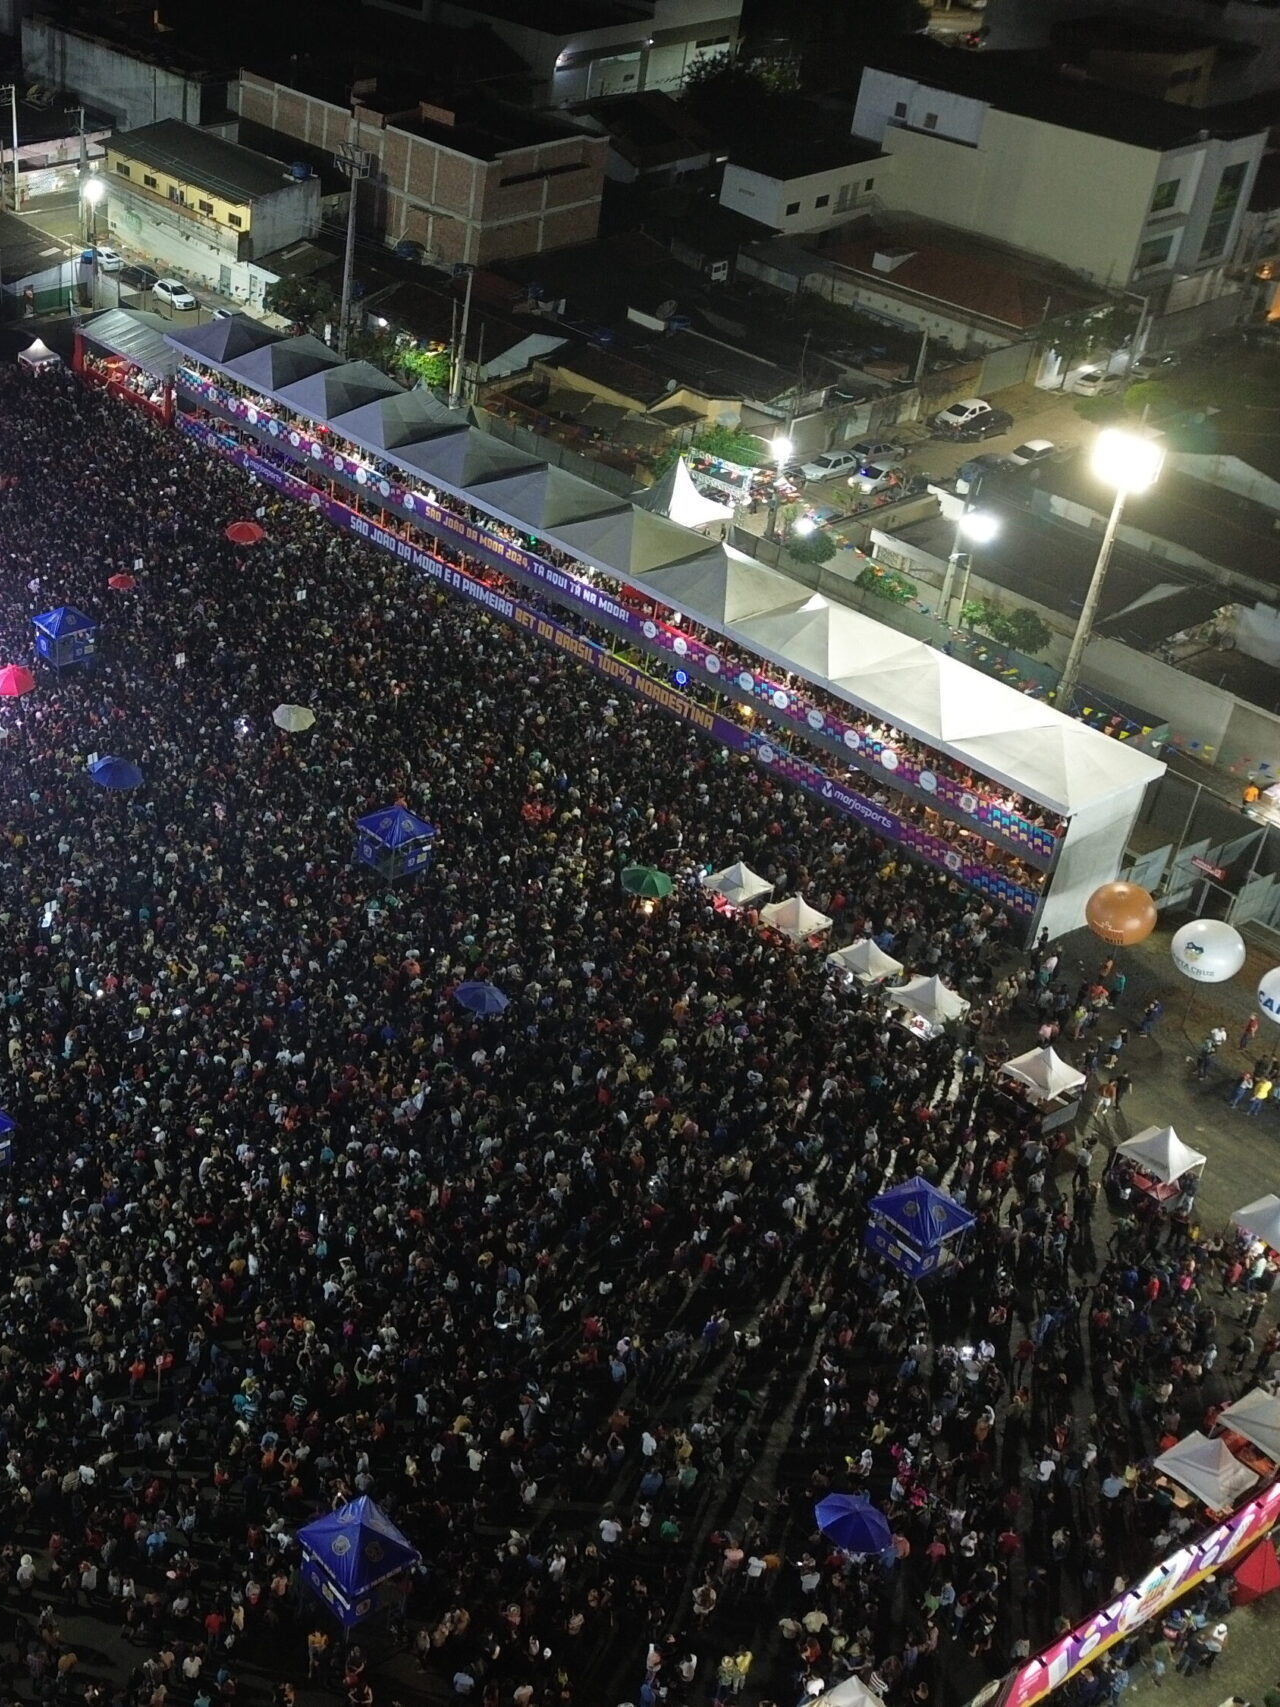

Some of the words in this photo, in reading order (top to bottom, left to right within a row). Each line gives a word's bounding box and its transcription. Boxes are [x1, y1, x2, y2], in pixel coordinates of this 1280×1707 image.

[350, 515, 369, 537] SÃO
[370, 528, 396, 552] JOÃO
[397, 542, 411, 561] DA
[412, 551, 442, 579] MODA
[444, 568, 451, 582] E
[452, 572, 460, 588] A
[462, 577, 513, 618] PRIMEIRA
[514, 606, 537, 629] BET
[537, 622, 553, 640] DO
[555, 631, 595, 665] BRASIL
[598, 650, 633, 684] 100%
[635, 675, 714, 731] NORDESTINA
[425, 505, 441, 523] SÃO
[443, 514, 464, 535] JOÃO
[466, 527, 478, 541] DA
[479, 534, 505, 554] MODA
[505, 548, 531, 571] 2024,
[533, 561, 545, 577] TÁ
[546, 568, 568, 589] AQUI
[569, 579, 581, 597] TÁ
[583, 588, 597, 606] NA
[598, 596, 630, 623] MODA!
[833, 789, 893, 830] marjosports
